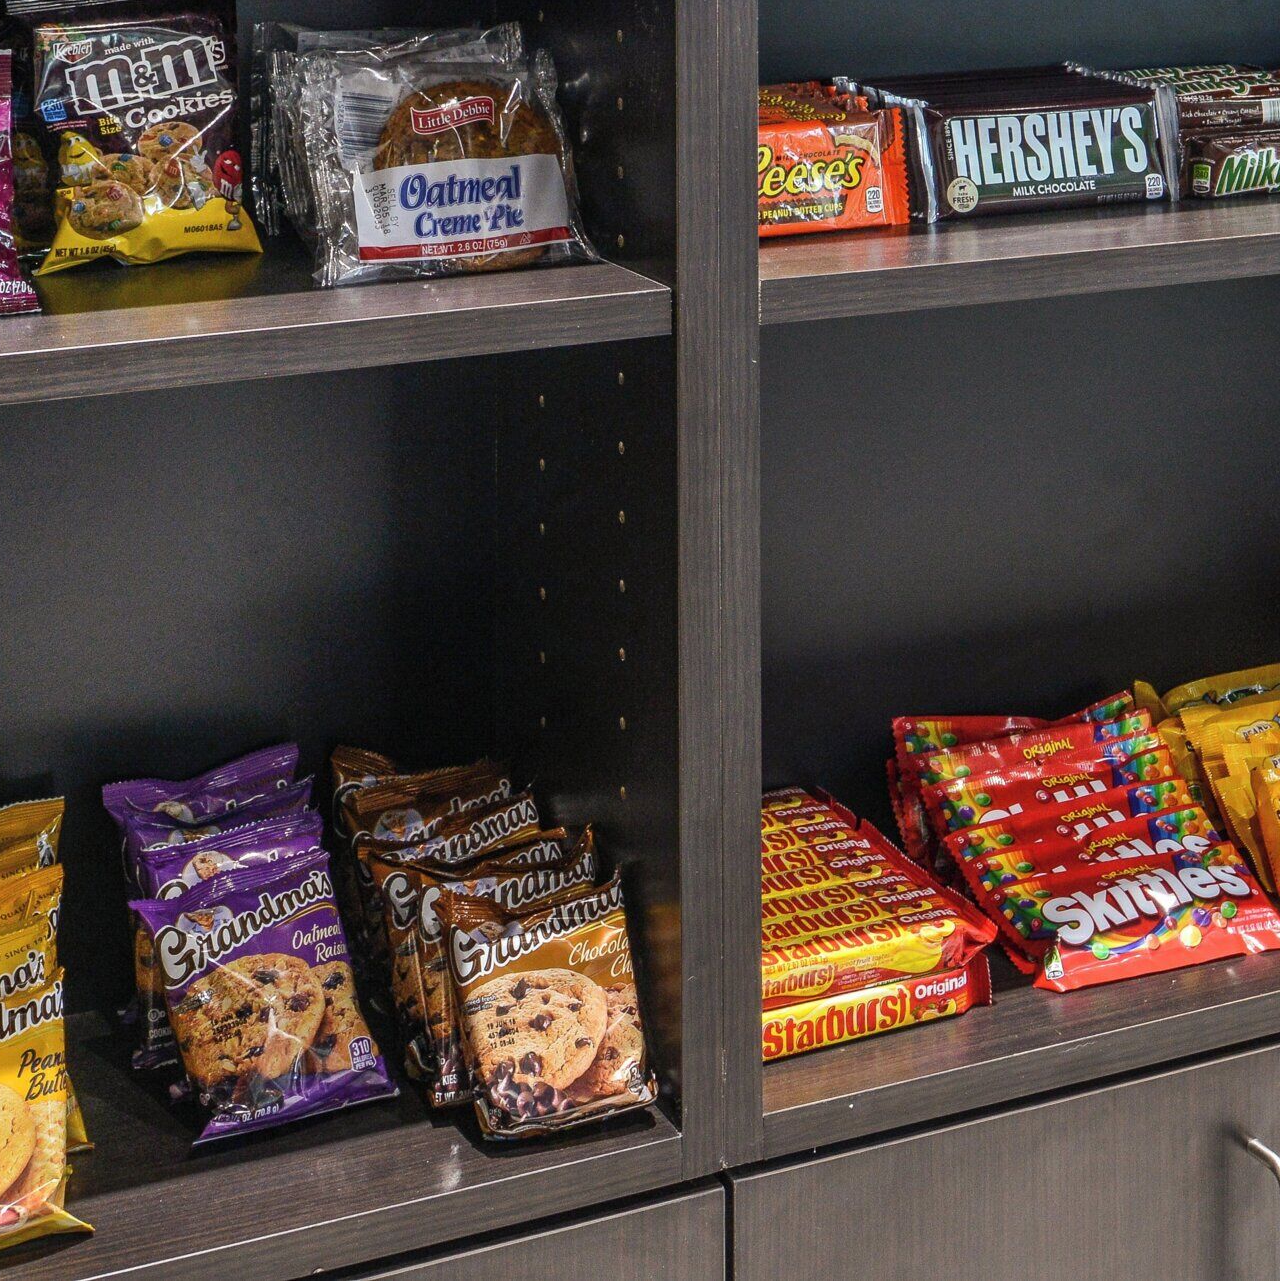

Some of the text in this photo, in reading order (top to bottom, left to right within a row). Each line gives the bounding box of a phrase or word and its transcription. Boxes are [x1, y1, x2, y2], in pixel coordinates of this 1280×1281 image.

[53, 42, 92, 63] Keebler
[104, 37, 155, 55] made with
[65, 36, 225, 116] m&m's
[125, 88, 234, 129] Cookies
[418, 104, 491, 130] Little Debbie
[100, 125, 122, 135] Size
[950, 108, 1149, 186] HERSHEY'S
[400, 164, 521, 211] Oatmeal
[1013, 180, 1096, 197] MILK CHOCOLATE
[1147, 177, 1160, 187] 220
[867, 190, 880, 200] 220
[953, 196, 975, 204] FRESH
[763, 207, 793, 219] PEANUT
[824, 202, 843, 212] CUPS
[414, 204, 525, 238] Creme Pie
[472, 241, 483, 249] OZ
[816, 839, 870, 852] Original
[830, 854, 886, 868] Original
[879, 887, 936, 904] Original
[1042, 865, 1252, 945] Skittles
[900, 909, 957, 923] Original
[155, 871, 333, 990] Grandma's
[292, 924, 342, 950] Oatmeal
[762, 918, 901, 967] Starburst
[915, 972, 967, 999] Original
[762, 987, 910, 1058] Starburst
[351, 1039, 370, 1056] 310
